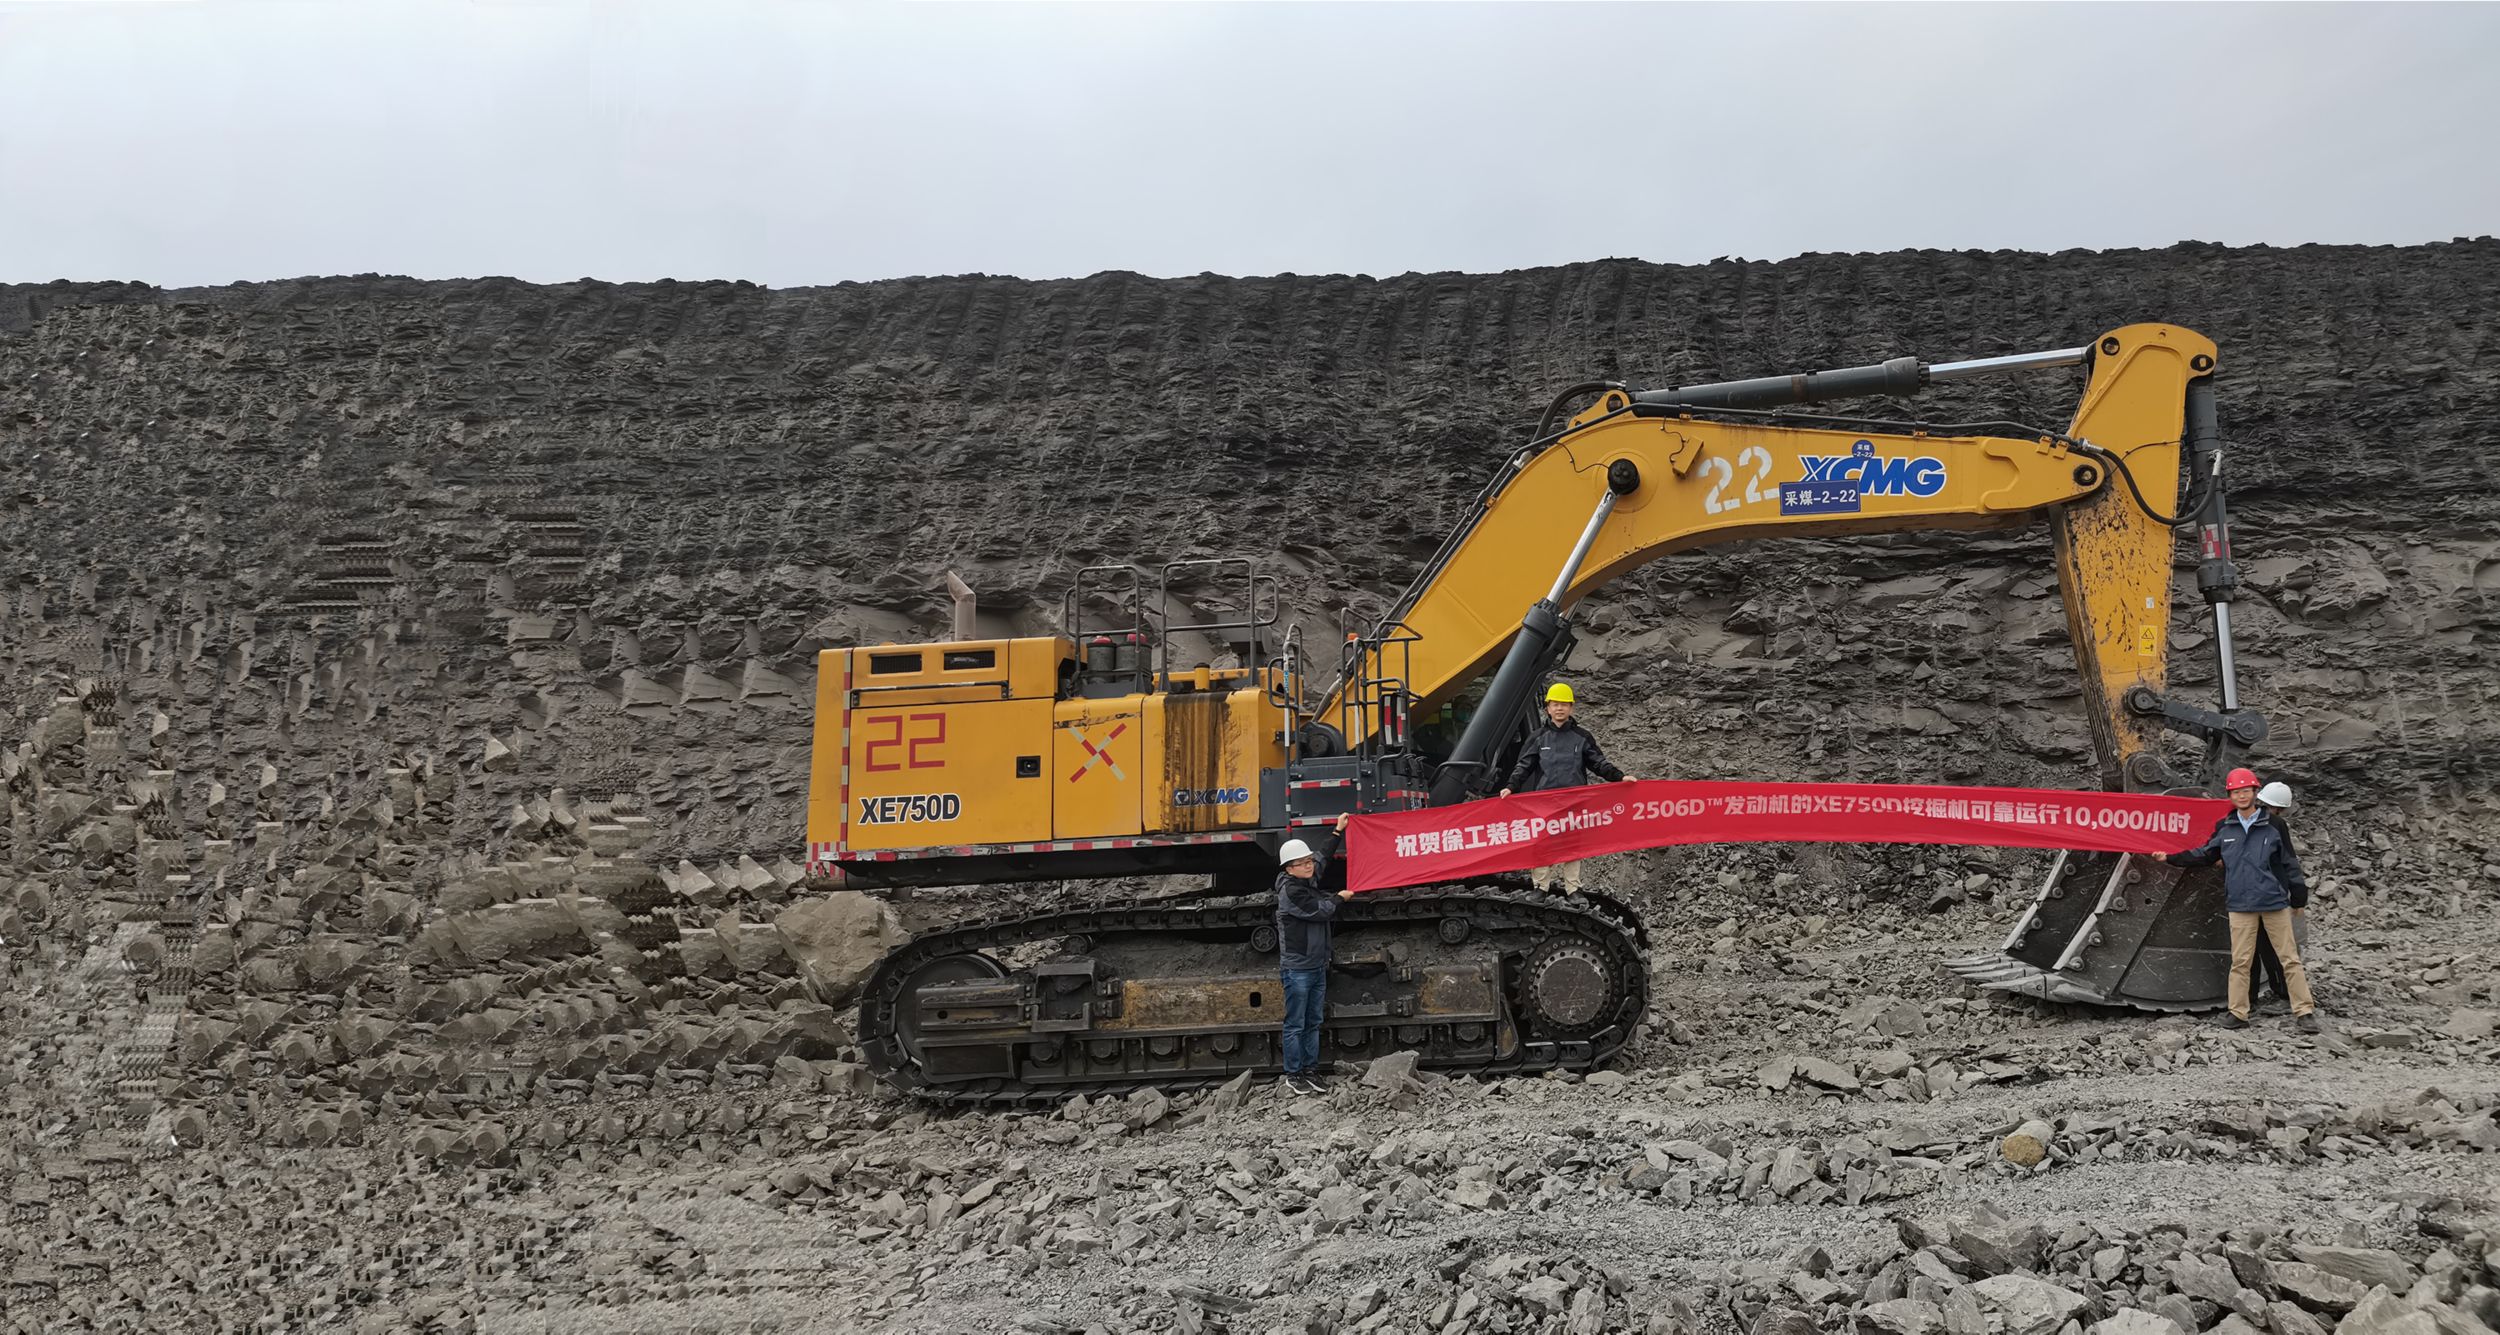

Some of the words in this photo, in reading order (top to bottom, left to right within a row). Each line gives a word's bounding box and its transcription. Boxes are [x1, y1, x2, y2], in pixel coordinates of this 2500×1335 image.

[1698, 446, 1781, 515] 22
[1799, 454, 1946, 498] XCMG
[1784, 489, 1857, 507] 采煤-2-22
[865, 712, 947, 773] 22
[858, 792, 961, 826] XE750D
[1191, 787, 1250, 806] XCMG
